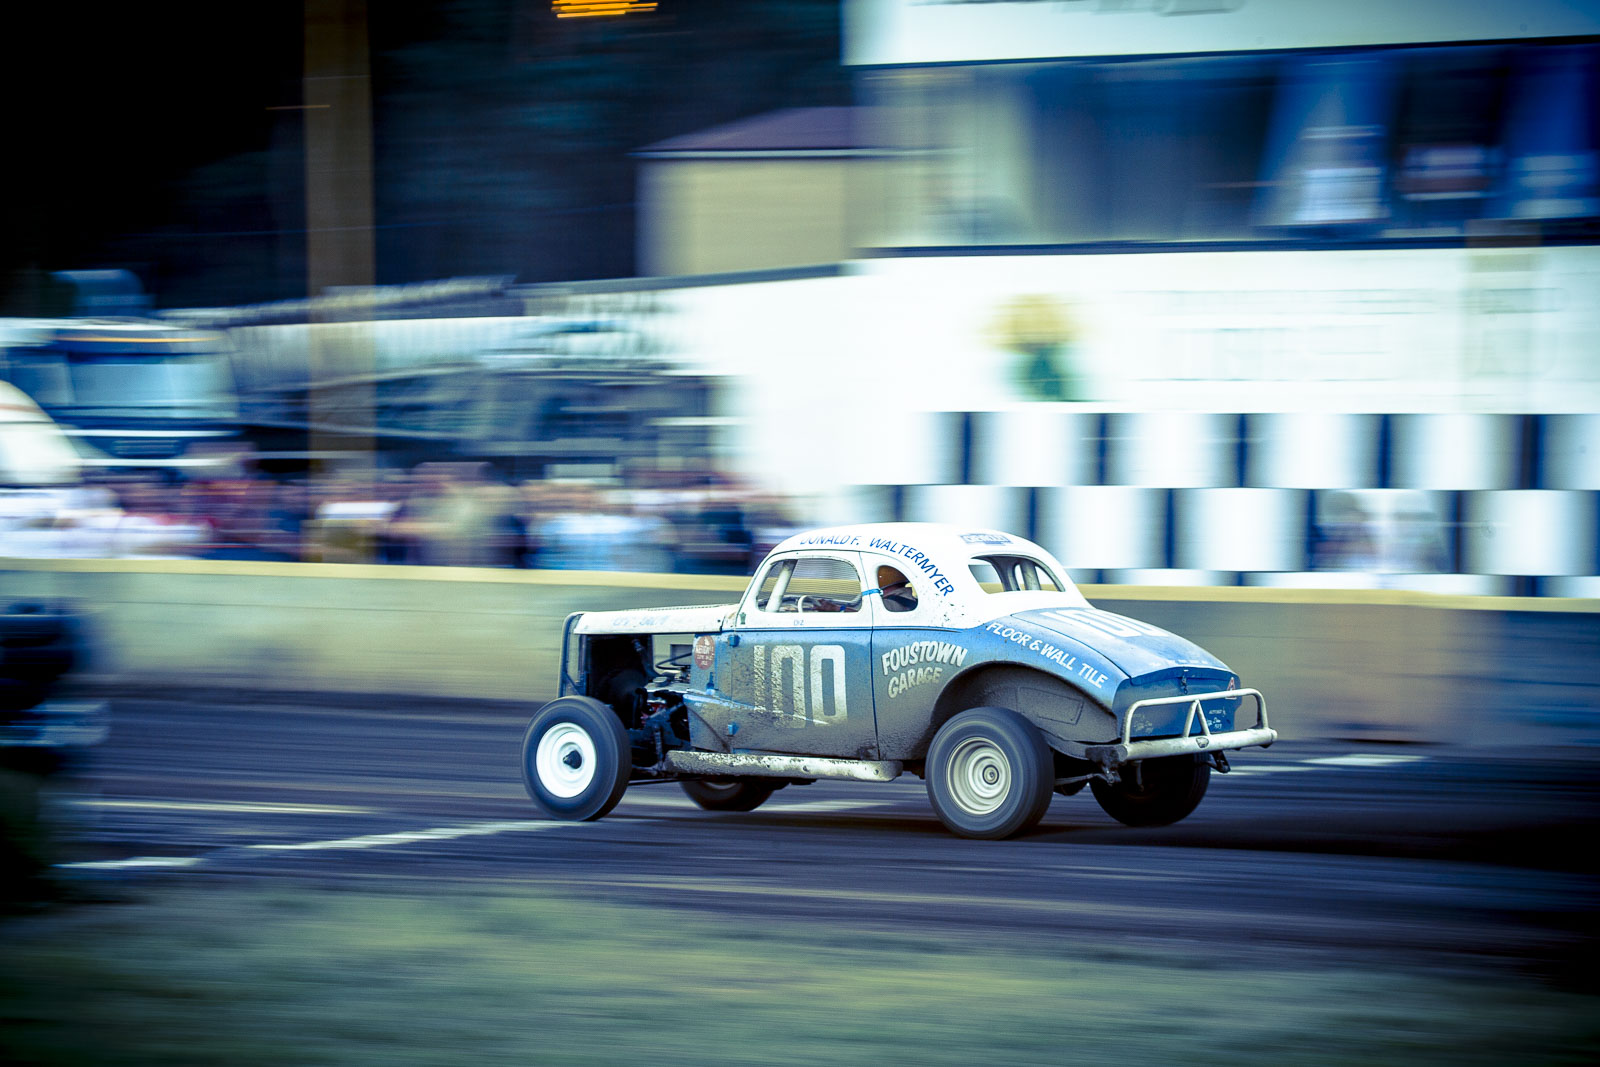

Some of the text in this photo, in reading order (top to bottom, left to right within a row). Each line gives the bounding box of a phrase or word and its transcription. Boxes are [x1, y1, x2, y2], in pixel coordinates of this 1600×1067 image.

[868, 537, 955, 597] WALTERMYER
[881, 640, 968, 676] FOUSTOWN
[888, 666, 943, 699] GARAGE
[986, 622, 1109, 689] FLOOR & WALL TILE
[753, 644, 848, 729] 100
